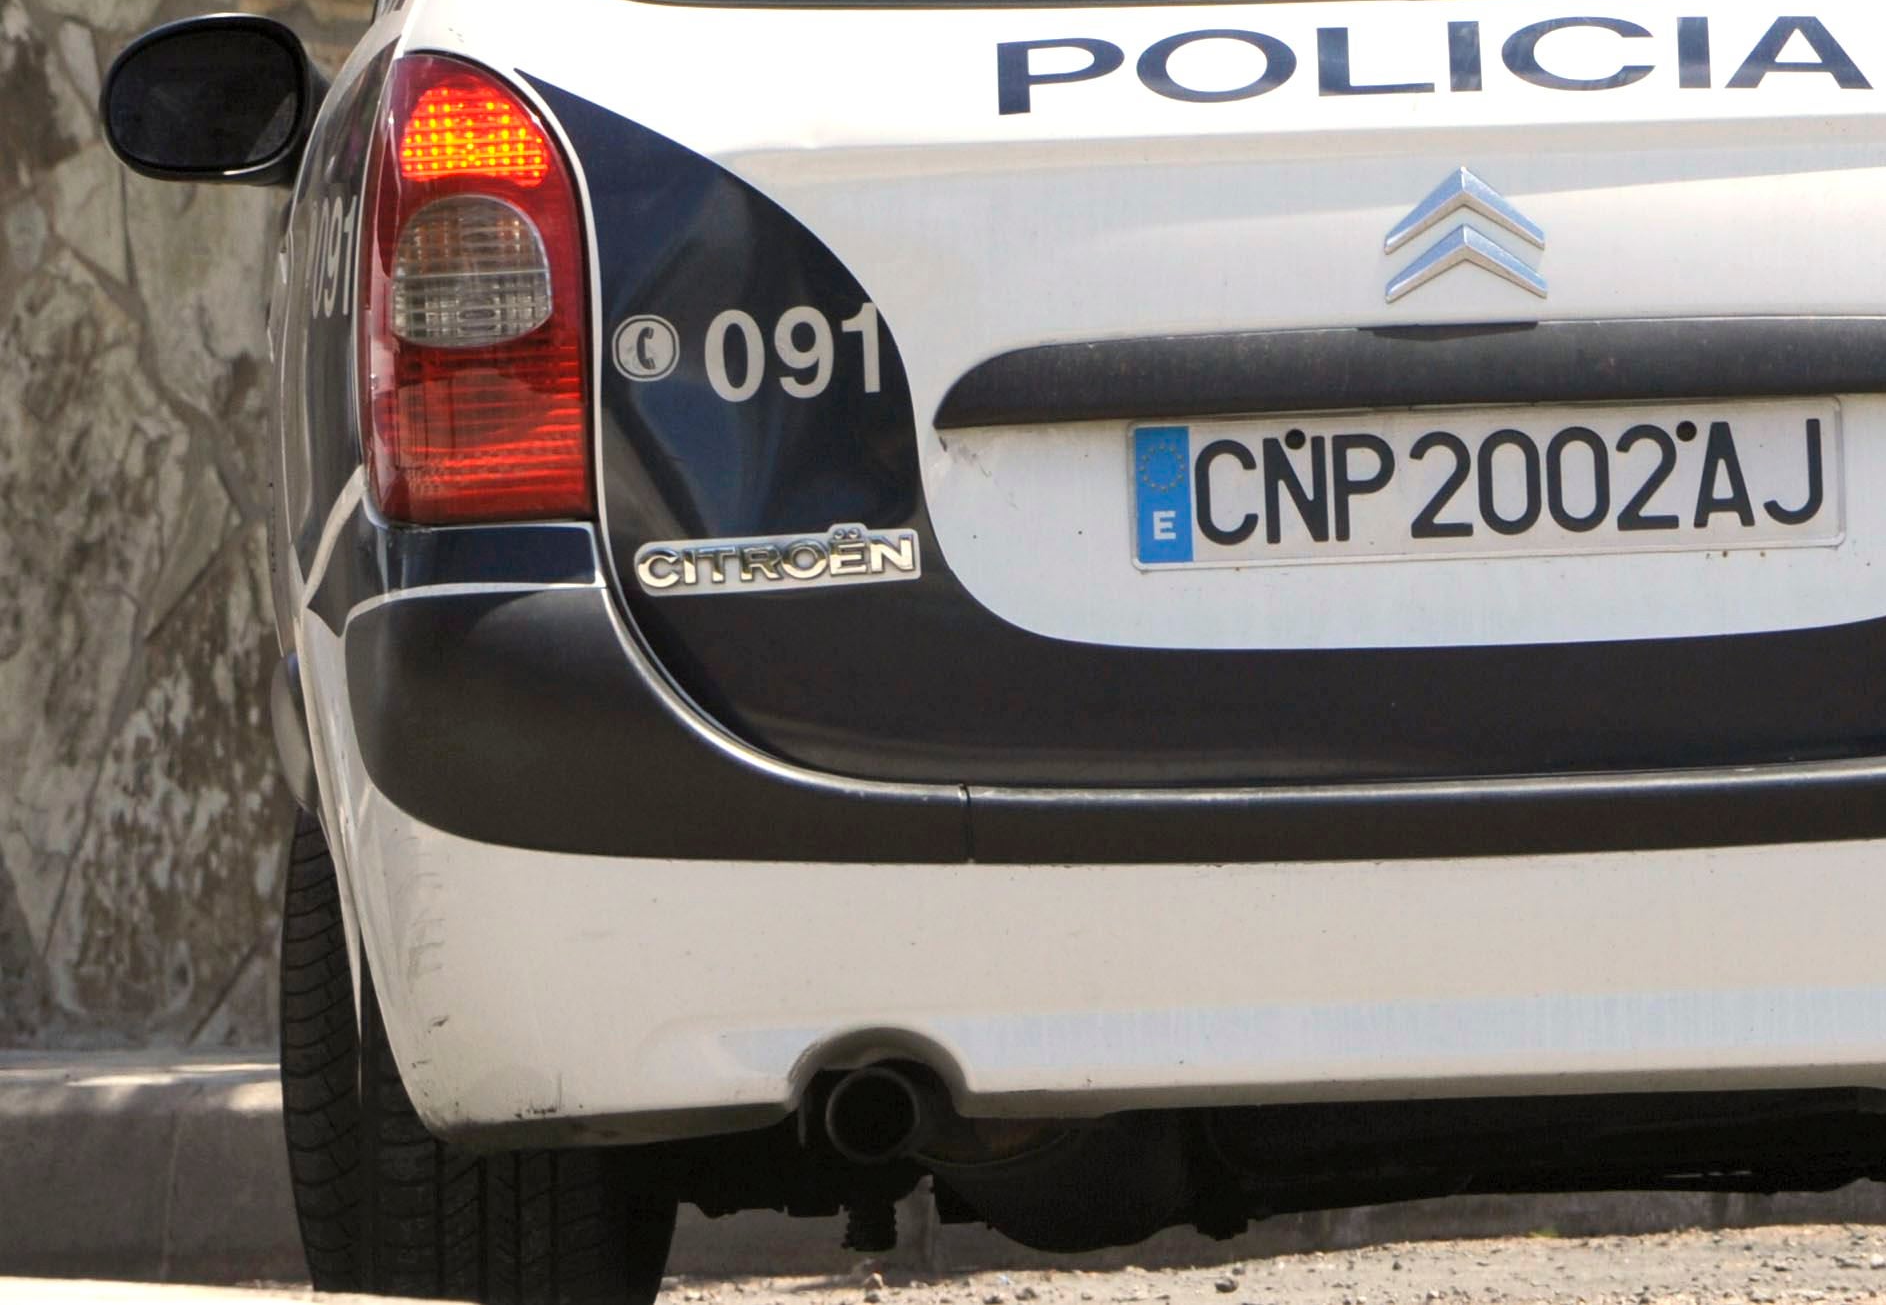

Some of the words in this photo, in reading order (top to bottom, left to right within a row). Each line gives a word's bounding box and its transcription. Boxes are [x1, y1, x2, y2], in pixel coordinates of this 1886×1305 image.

[997, 15, 1875, 116] POLICIA
[312, 195, 358, 320] 091
[703, 302, 888, 403] 091
[636, 527, 917, 591] CITROËN
[1152, 507, 1178, 541] E
